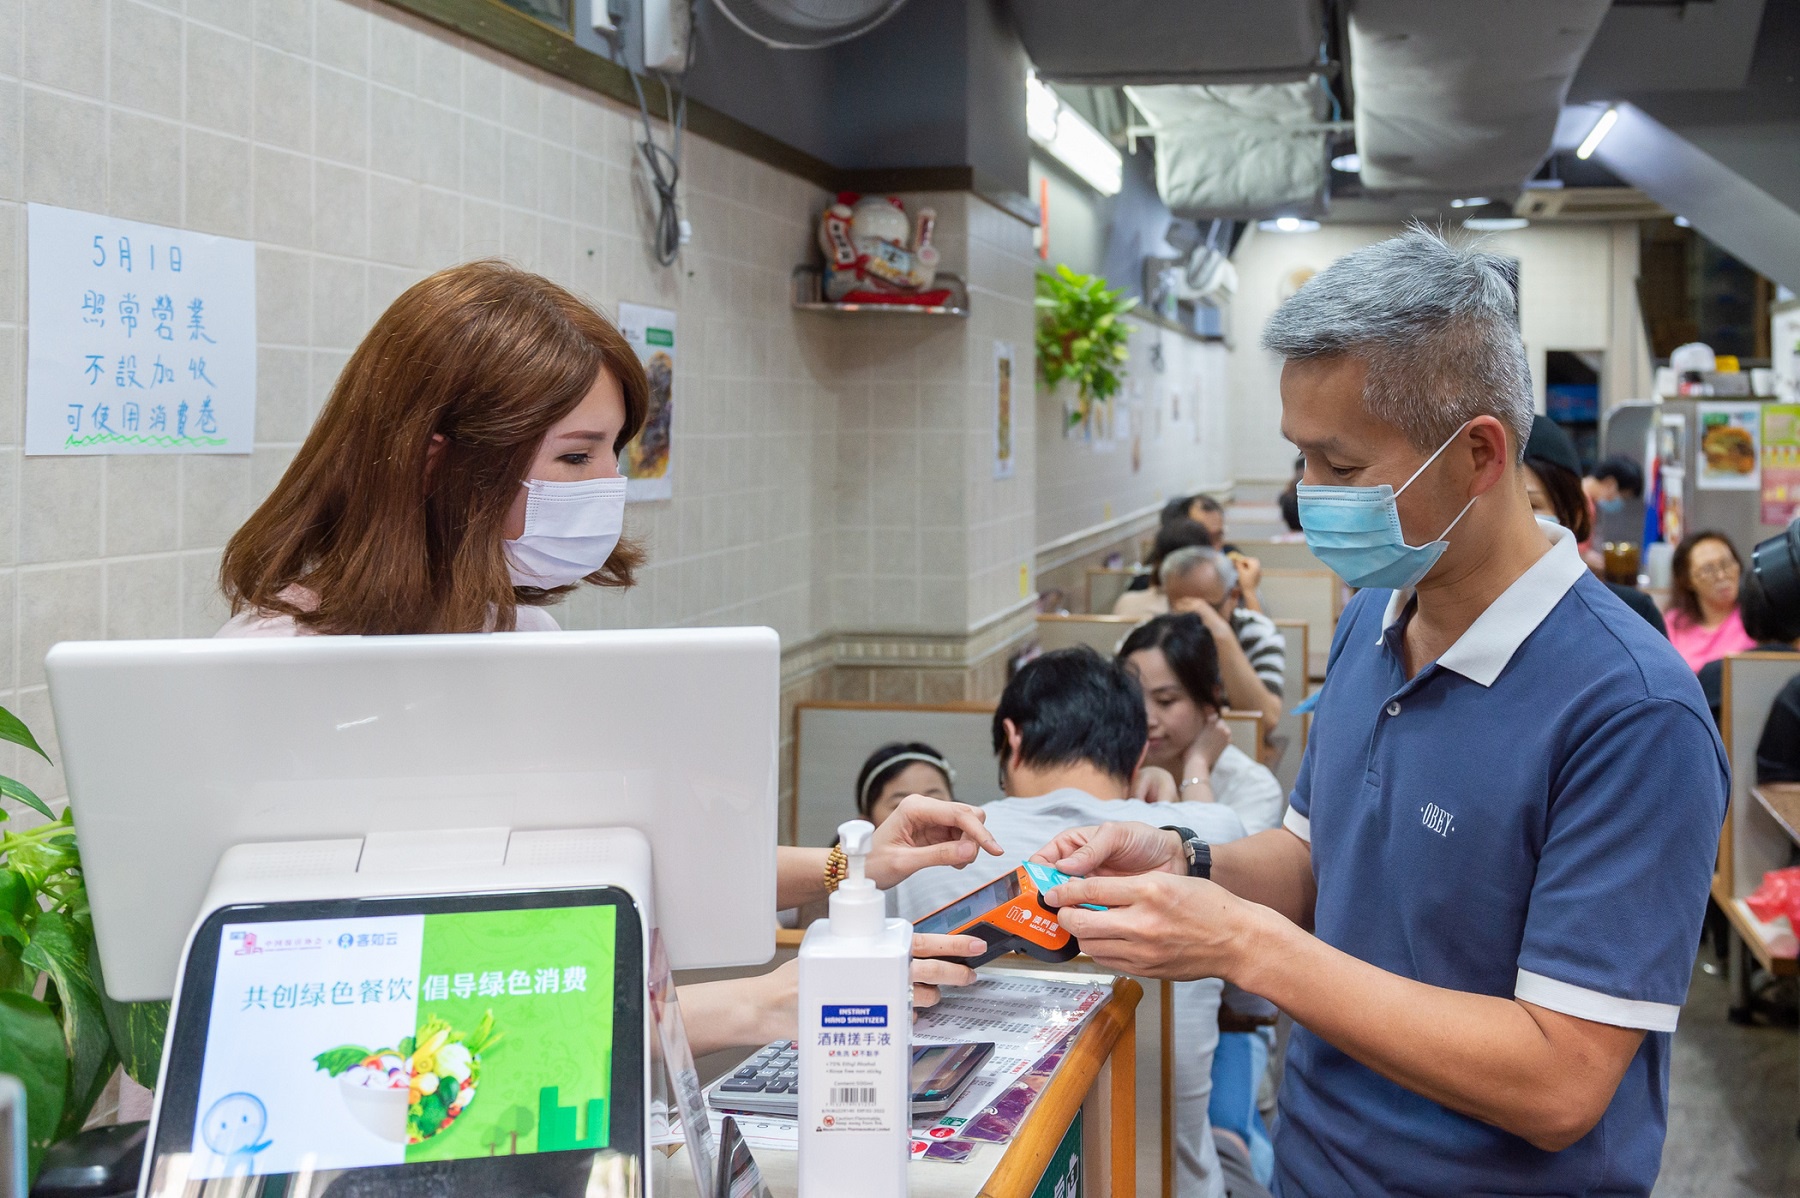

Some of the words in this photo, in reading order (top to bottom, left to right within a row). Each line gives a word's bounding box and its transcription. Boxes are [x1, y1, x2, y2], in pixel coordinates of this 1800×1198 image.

[93, 235, 182, 272] 5月1日
[81, 290, 216, 344] 照常營業
[84, 353, 216, 389] 不設加收
[1029, 923, 1046, 933] MACAU
[357, 932, 398, 947] 客如云
[241, 977, 413, 1012] 共创绿色餐饮
[422, 966, 587, 1001] 倡导绿色消费
[839, 1008, 871, 1016] INSTANT
[824, 1016, 846, 1024] HAND
[847, 1016, 885, 1024] SANITIZER
[818, 1032, 891, 1046] 酒精搓手液
